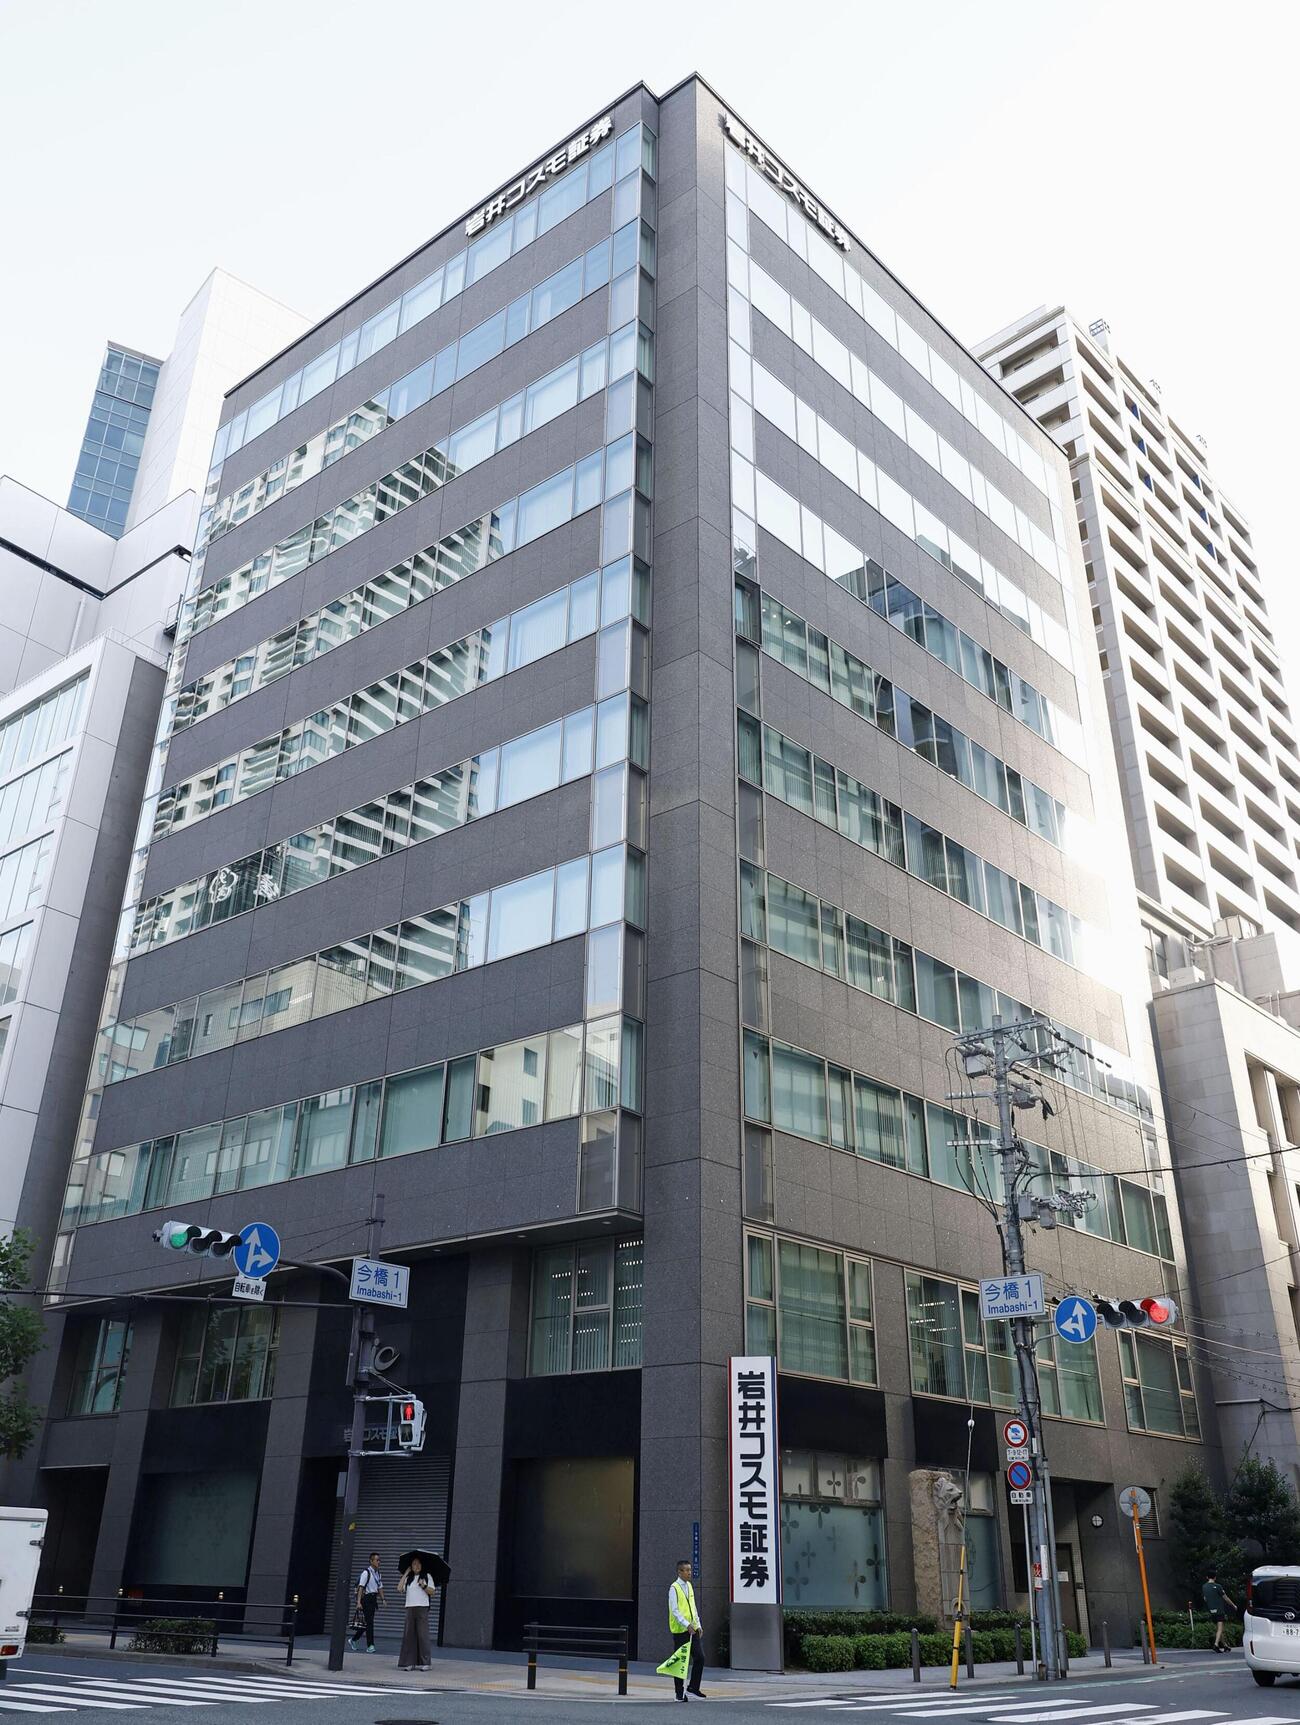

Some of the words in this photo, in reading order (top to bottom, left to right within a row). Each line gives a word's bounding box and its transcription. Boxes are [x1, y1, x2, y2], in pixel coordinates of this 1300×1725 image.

[465, 116, 612, 236] 岩井コスモ証券
[356, 1285, 402, 1301] Imabashi-1
[988, 1300, 1038, 1314] Imabashi-1
[737, 1370, 769, 1588] 岩井コスモ証券
